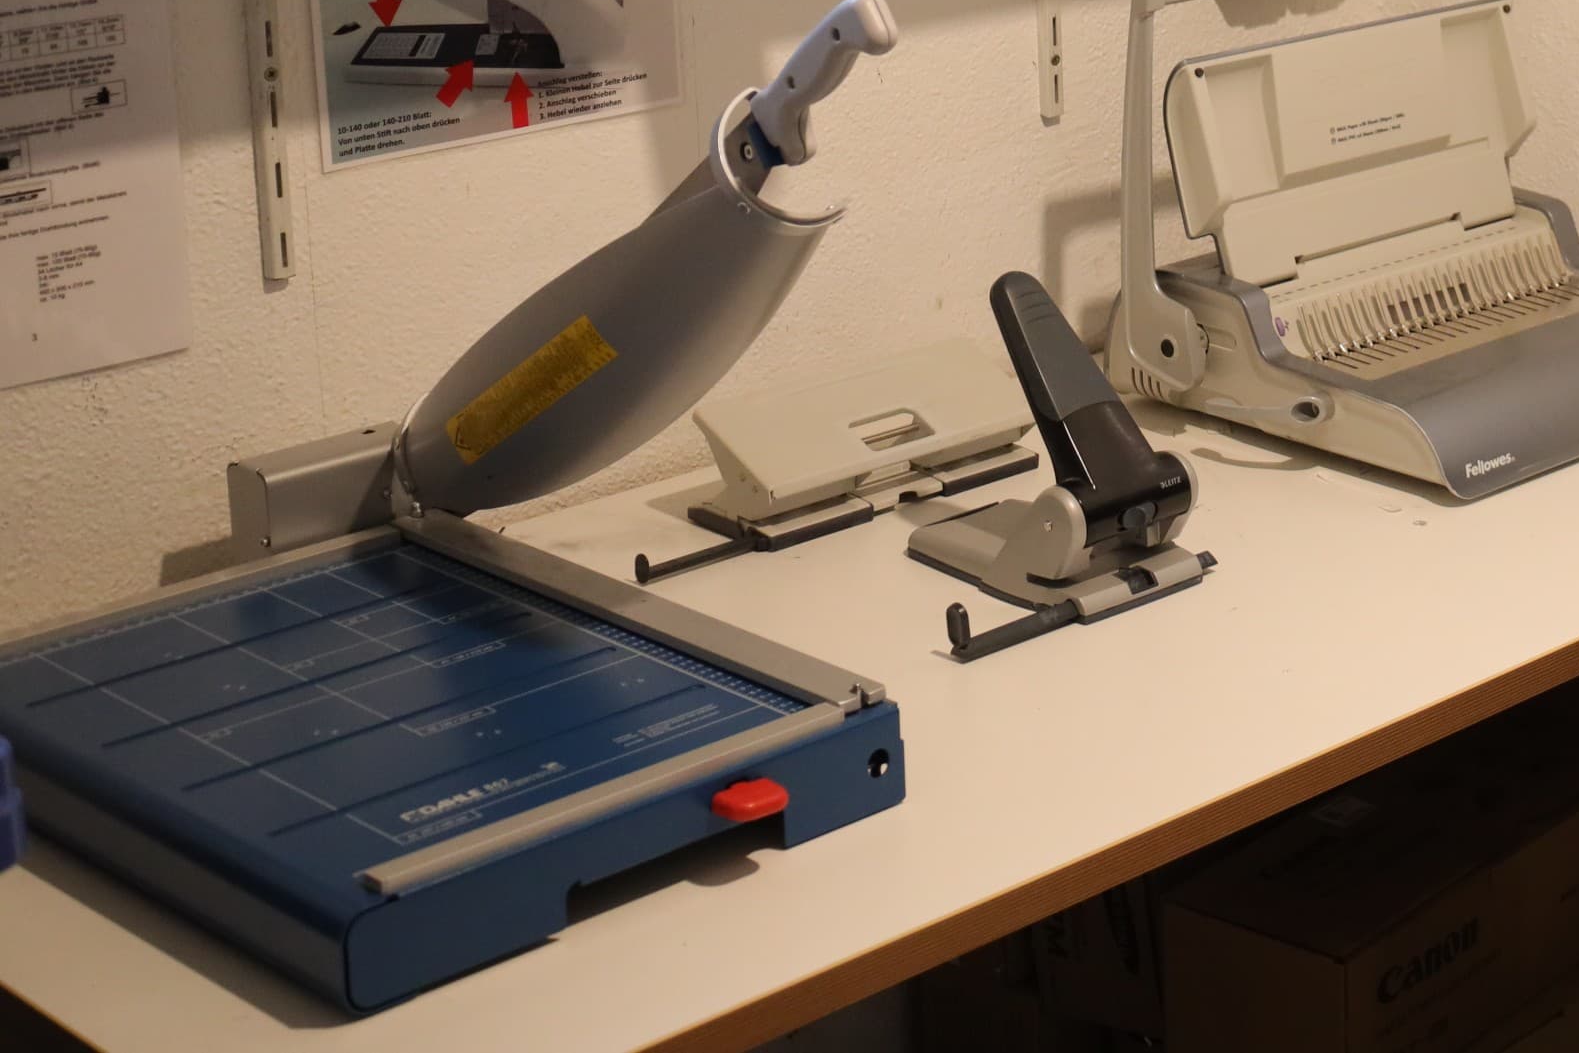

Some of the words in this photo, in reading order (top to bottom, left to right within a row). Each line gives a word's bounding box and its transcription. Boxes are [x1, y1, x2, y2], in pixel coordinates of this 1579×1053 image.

[593, 81, 603, 89] zur
[604, 78, 621, 87] Seite
[547, 96, 577, 108] Anschlag
[547, 108, 567, 119] Hebel
[568, 104, 592, 115] wieder
[338, 122, 362, 135] 10-140
[364, 120, 381, 130] oder
[338, 137, 353, 147] Von
[354, 133, 376, 143] unten
[377, 129, 392, 139] Stift
[393, 126, 411, 135] nach
[412, 122, 431, 132] oben
[431, 116, 461, 128] drücken
[339, 148, 354, 157] und
[354, 144, 376, 155] Platte
[1464, 452, 1513, 479] Fellowes
[1375, 914, 1480, 1004] Canon
